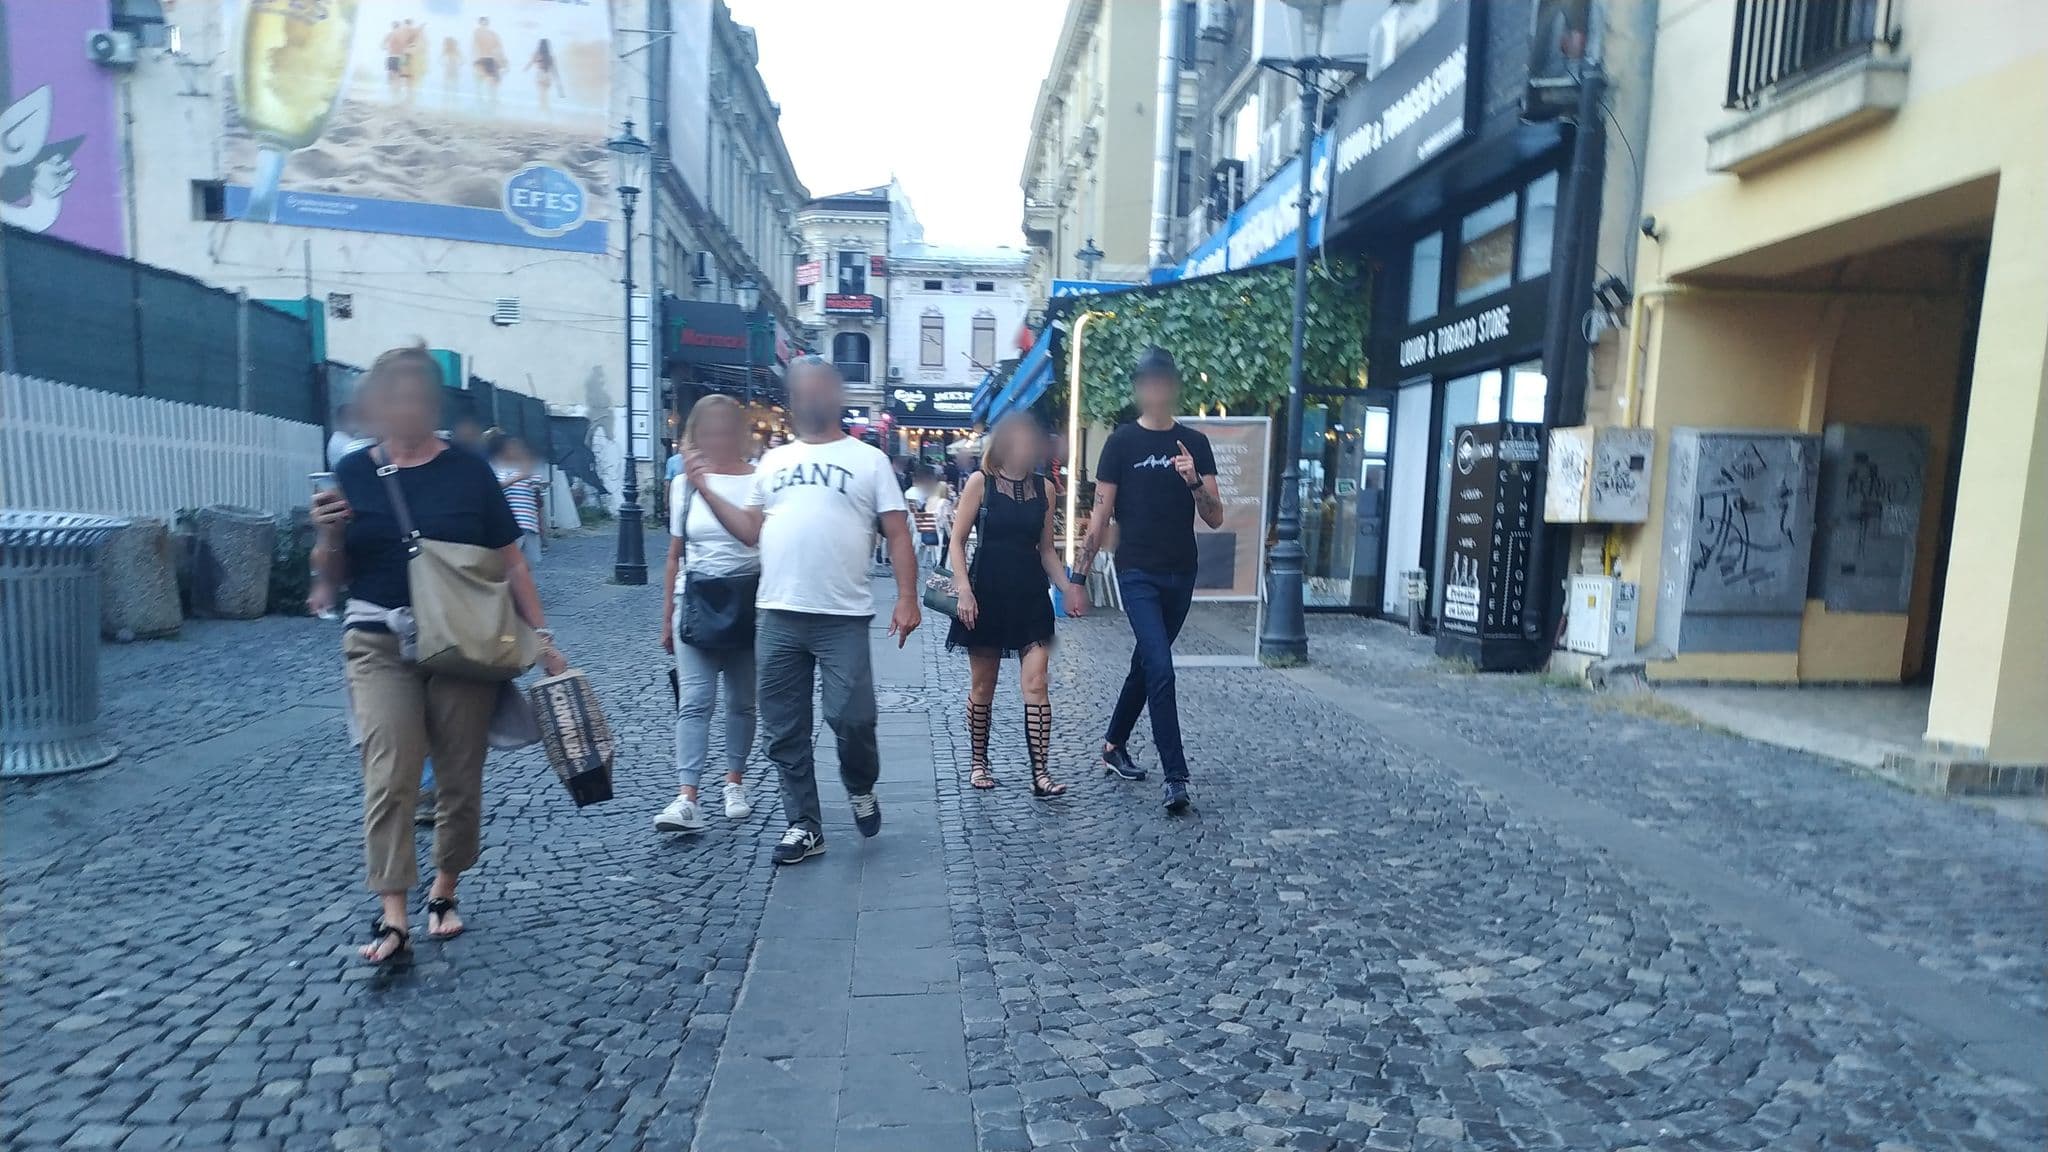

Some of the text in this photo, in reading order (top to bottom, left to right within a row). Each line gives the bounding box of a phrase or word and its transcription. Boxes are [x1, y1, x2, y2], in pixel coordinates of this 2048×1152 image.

[1381, 74, 1432, 143] TOBACCO
[511, 187, 578, 212] EFES
[1400, 303, 1510, 367] LIQUOR & TOBACCO STORE
[772, 462, 855, 494] GANT
[1519, 470, 1532, 529] WINE
[1487, 469, 1508, 626] CIGARETTES
[1512, 539, 1525, 626] LIQUOR
